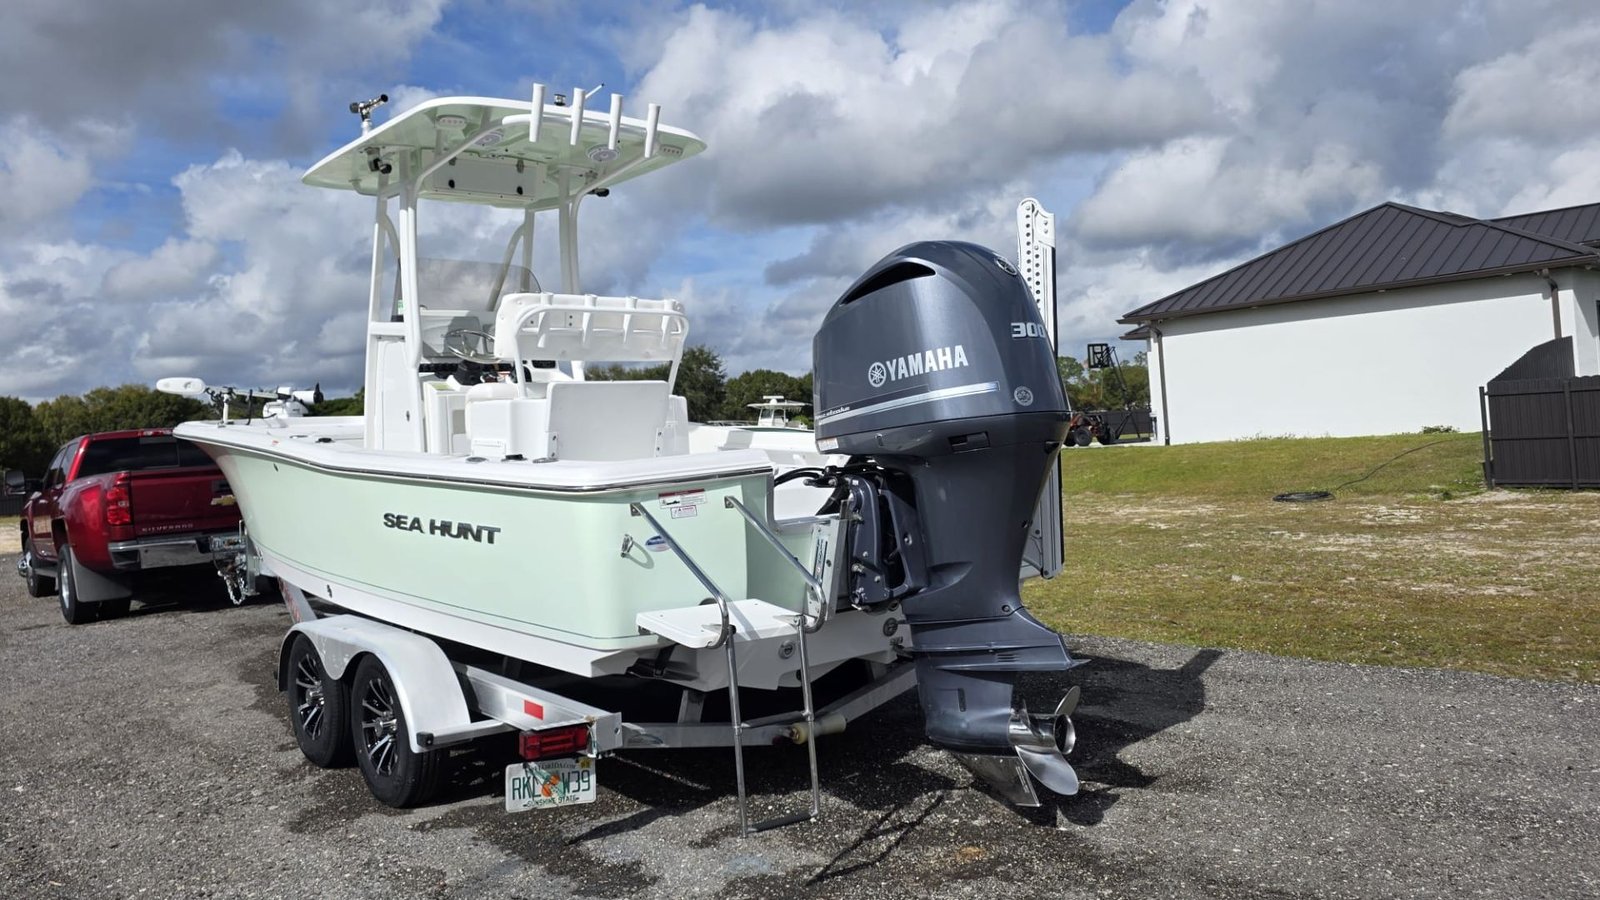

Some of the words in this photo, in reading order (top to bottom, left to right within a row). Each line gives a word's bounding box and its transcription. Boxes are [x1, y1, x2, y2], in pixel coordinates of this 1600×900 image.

[1011, 322, 1046, 338] 300
[886, 345, 969, 381] YAMAHA
[383, 513, 425, 534] SEA
[429, 518, 501, 544] HUNT
